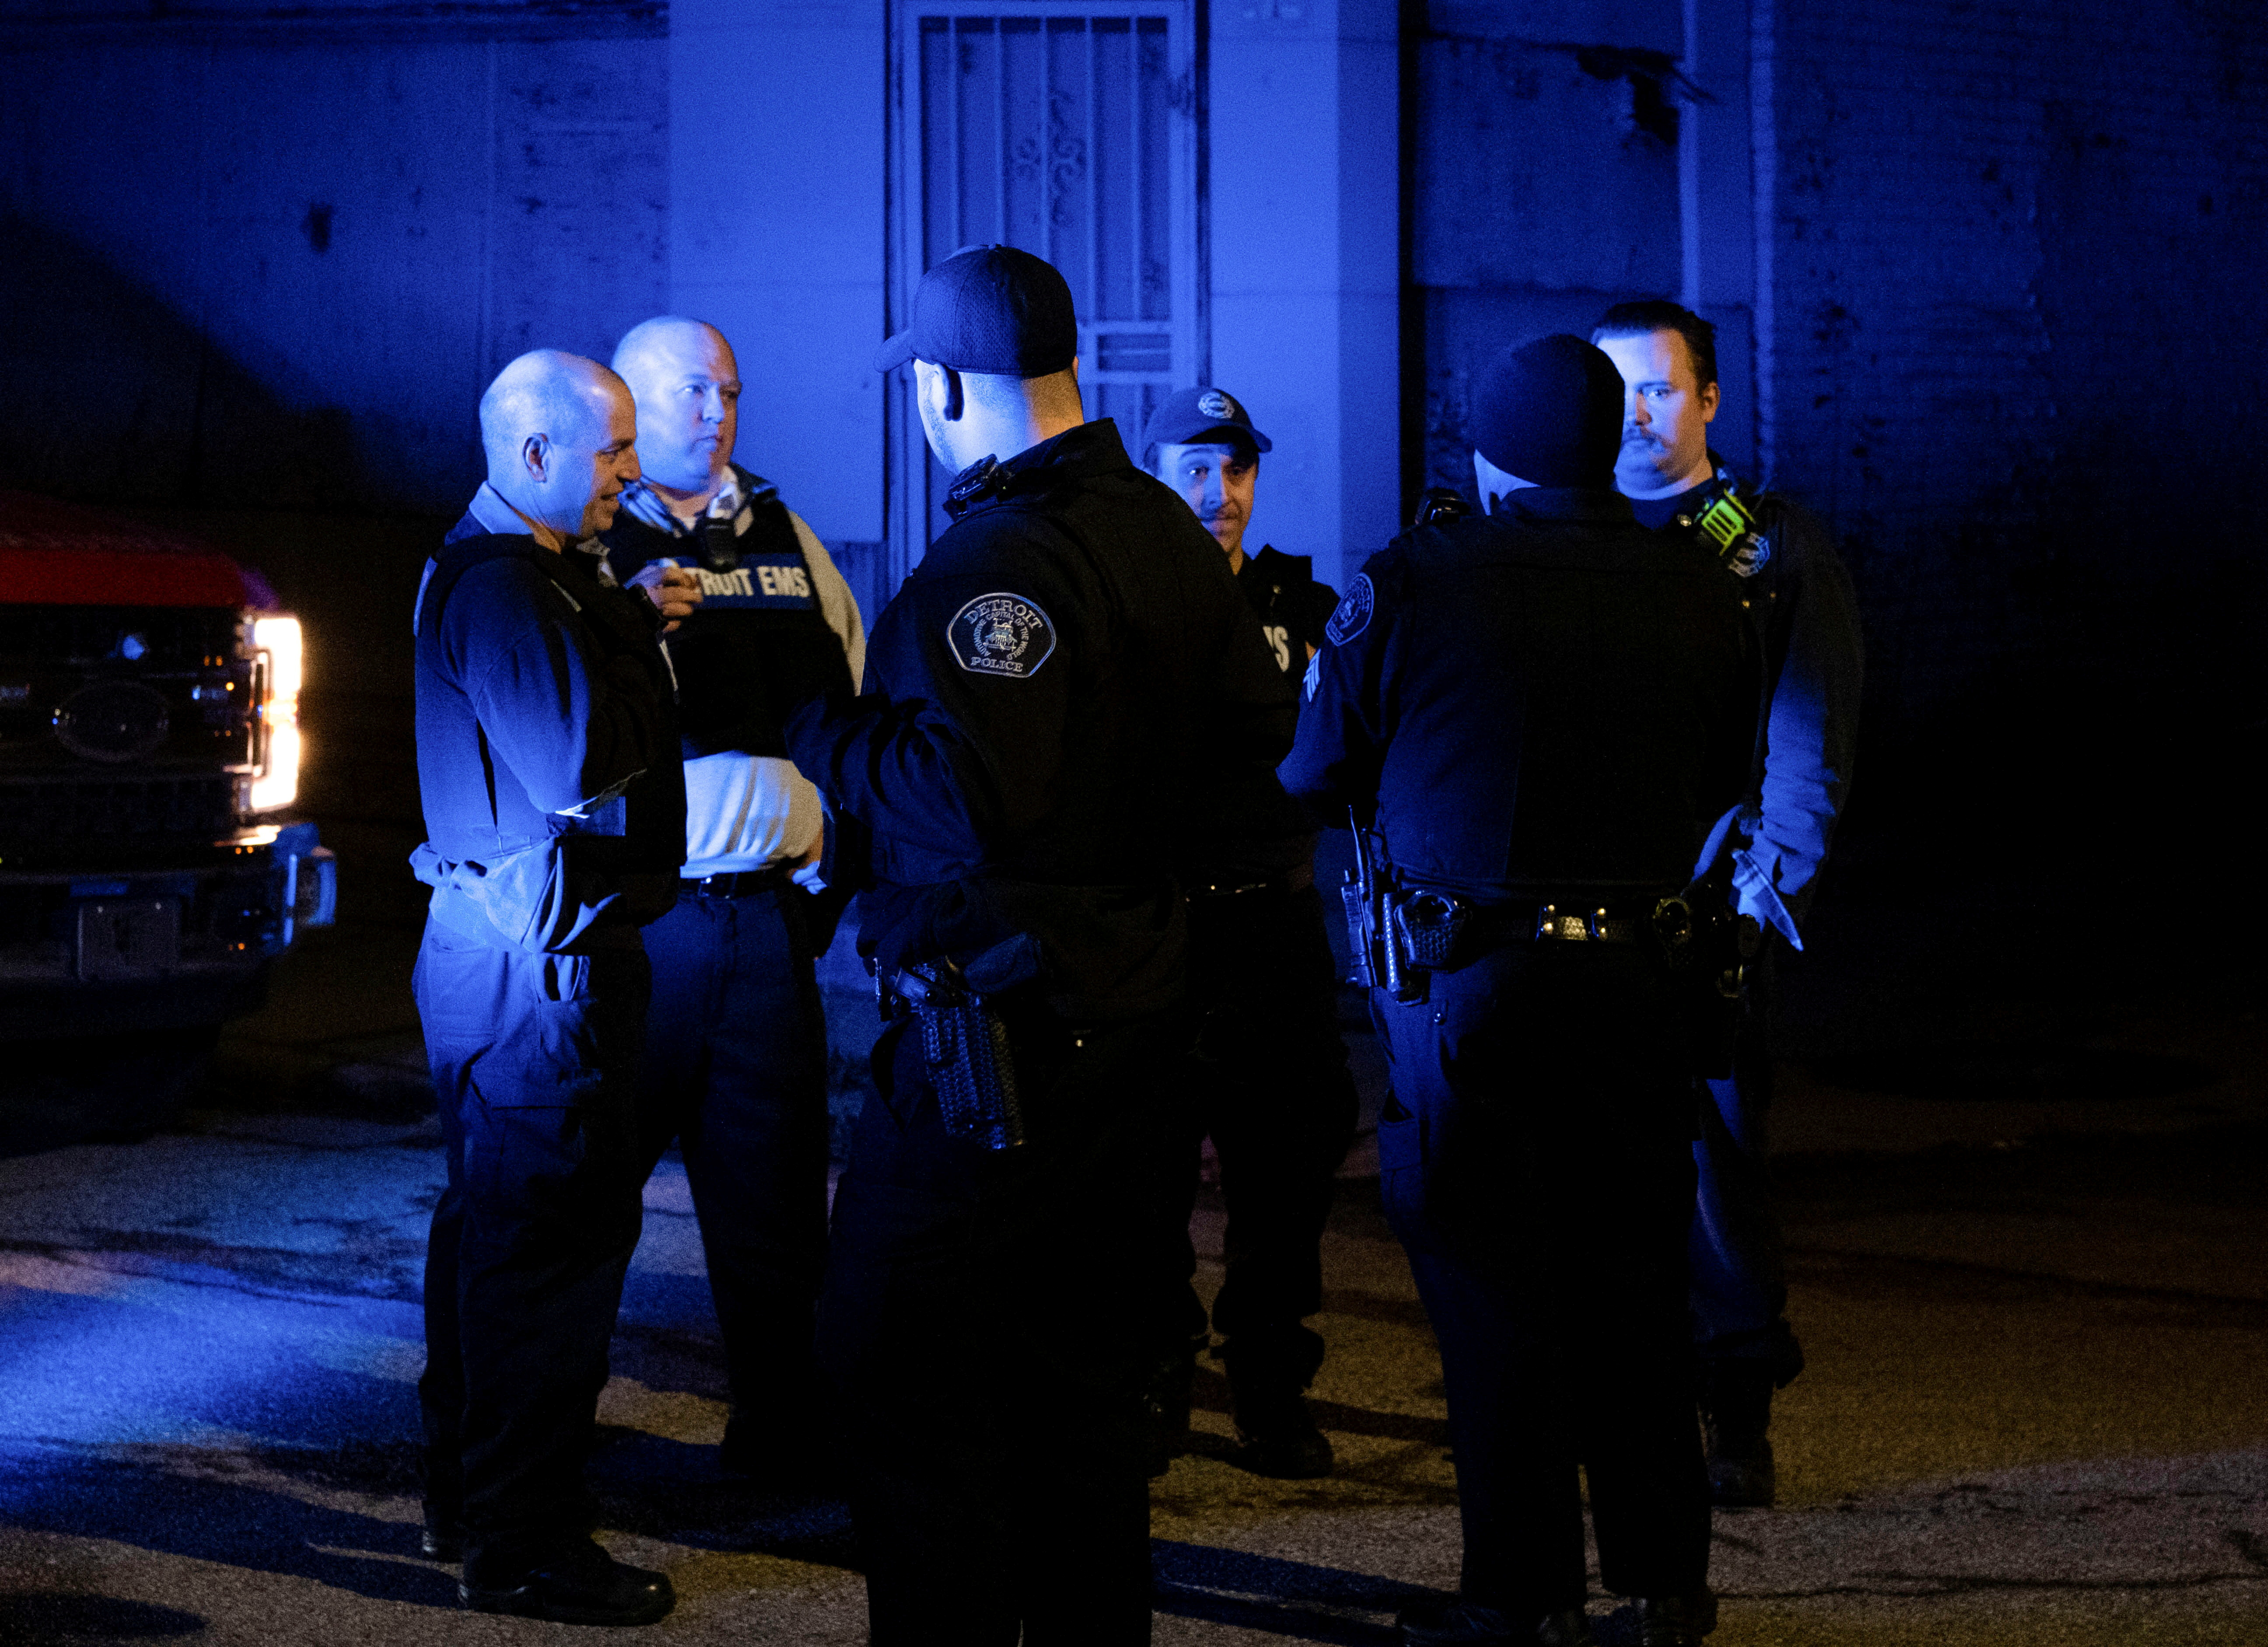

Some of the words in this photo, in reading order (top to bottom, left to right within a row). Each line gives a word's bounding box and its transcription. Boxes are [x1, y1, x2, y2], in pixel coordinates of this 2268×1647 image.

[757, 566, 811, 598] EMS
[963, 599, 1043, 629] DETROIT
[971, 656, 1023, 672] POLICE
